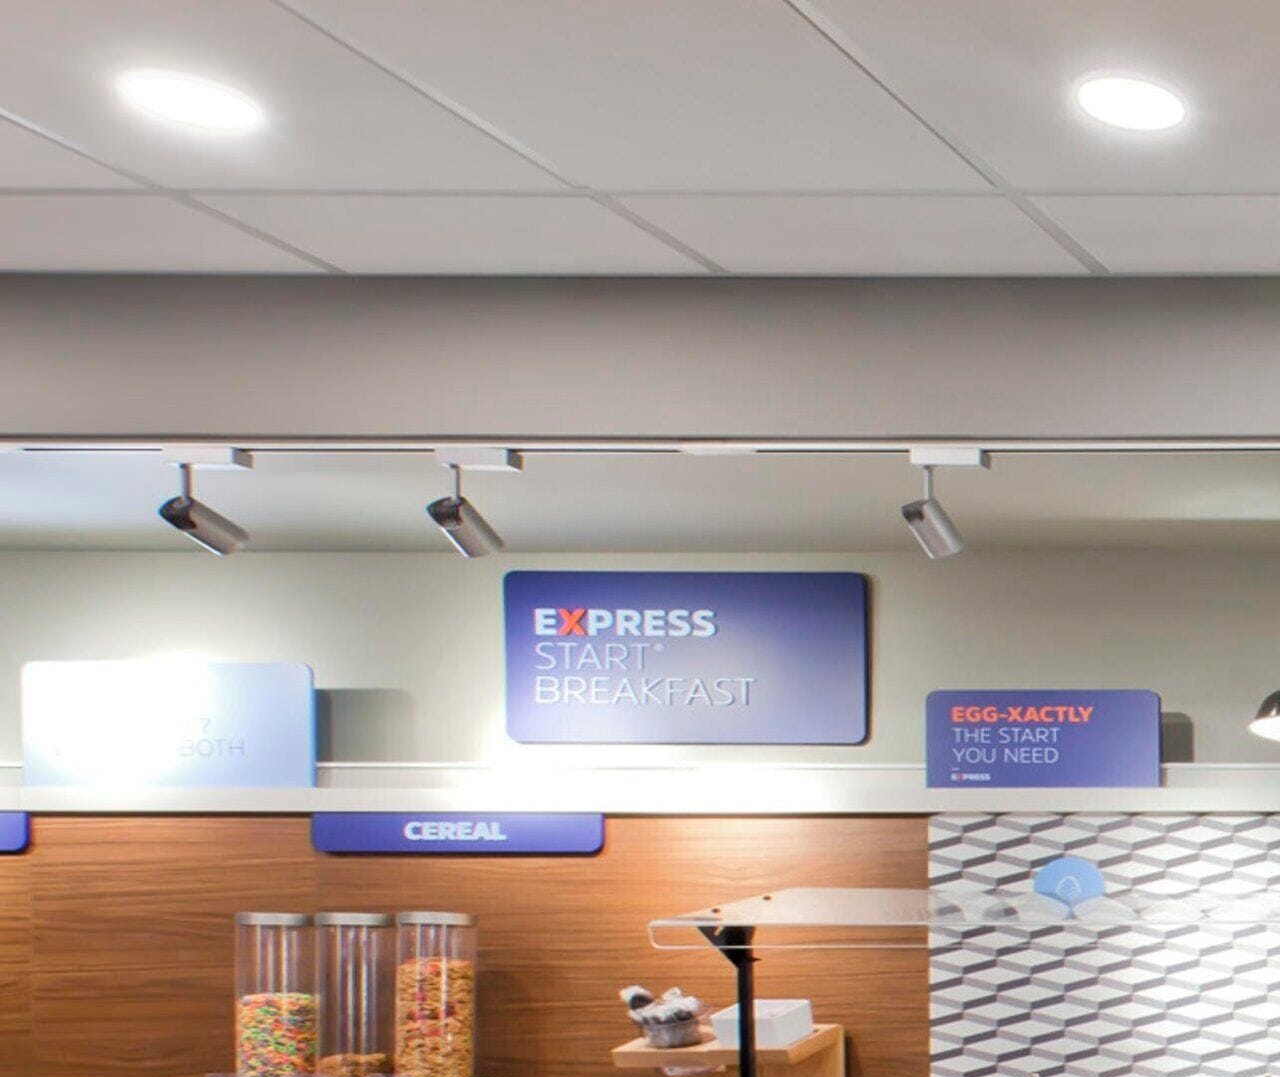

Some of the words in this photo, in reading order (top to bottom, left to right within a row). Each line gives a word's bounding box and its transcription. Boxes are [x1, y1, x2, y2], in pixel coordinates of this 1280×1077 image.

[534, 608, 717, 637] EXPRESS
[534, 675, 756, 706] BREAKFAST
[951, 706, 1094, 723] EGG-XACTLY
[952, 727, 992, 744] THE
[998, 727, 1060, 744] START
[179, 738, 245, 757] BOTH
[952, 748, 996, 764] YOU
[1004, 748, 1059, 764] NEED
[950, 773, 991, 782] EXPRESS
[404, 821, 508, 841] CEREAL
